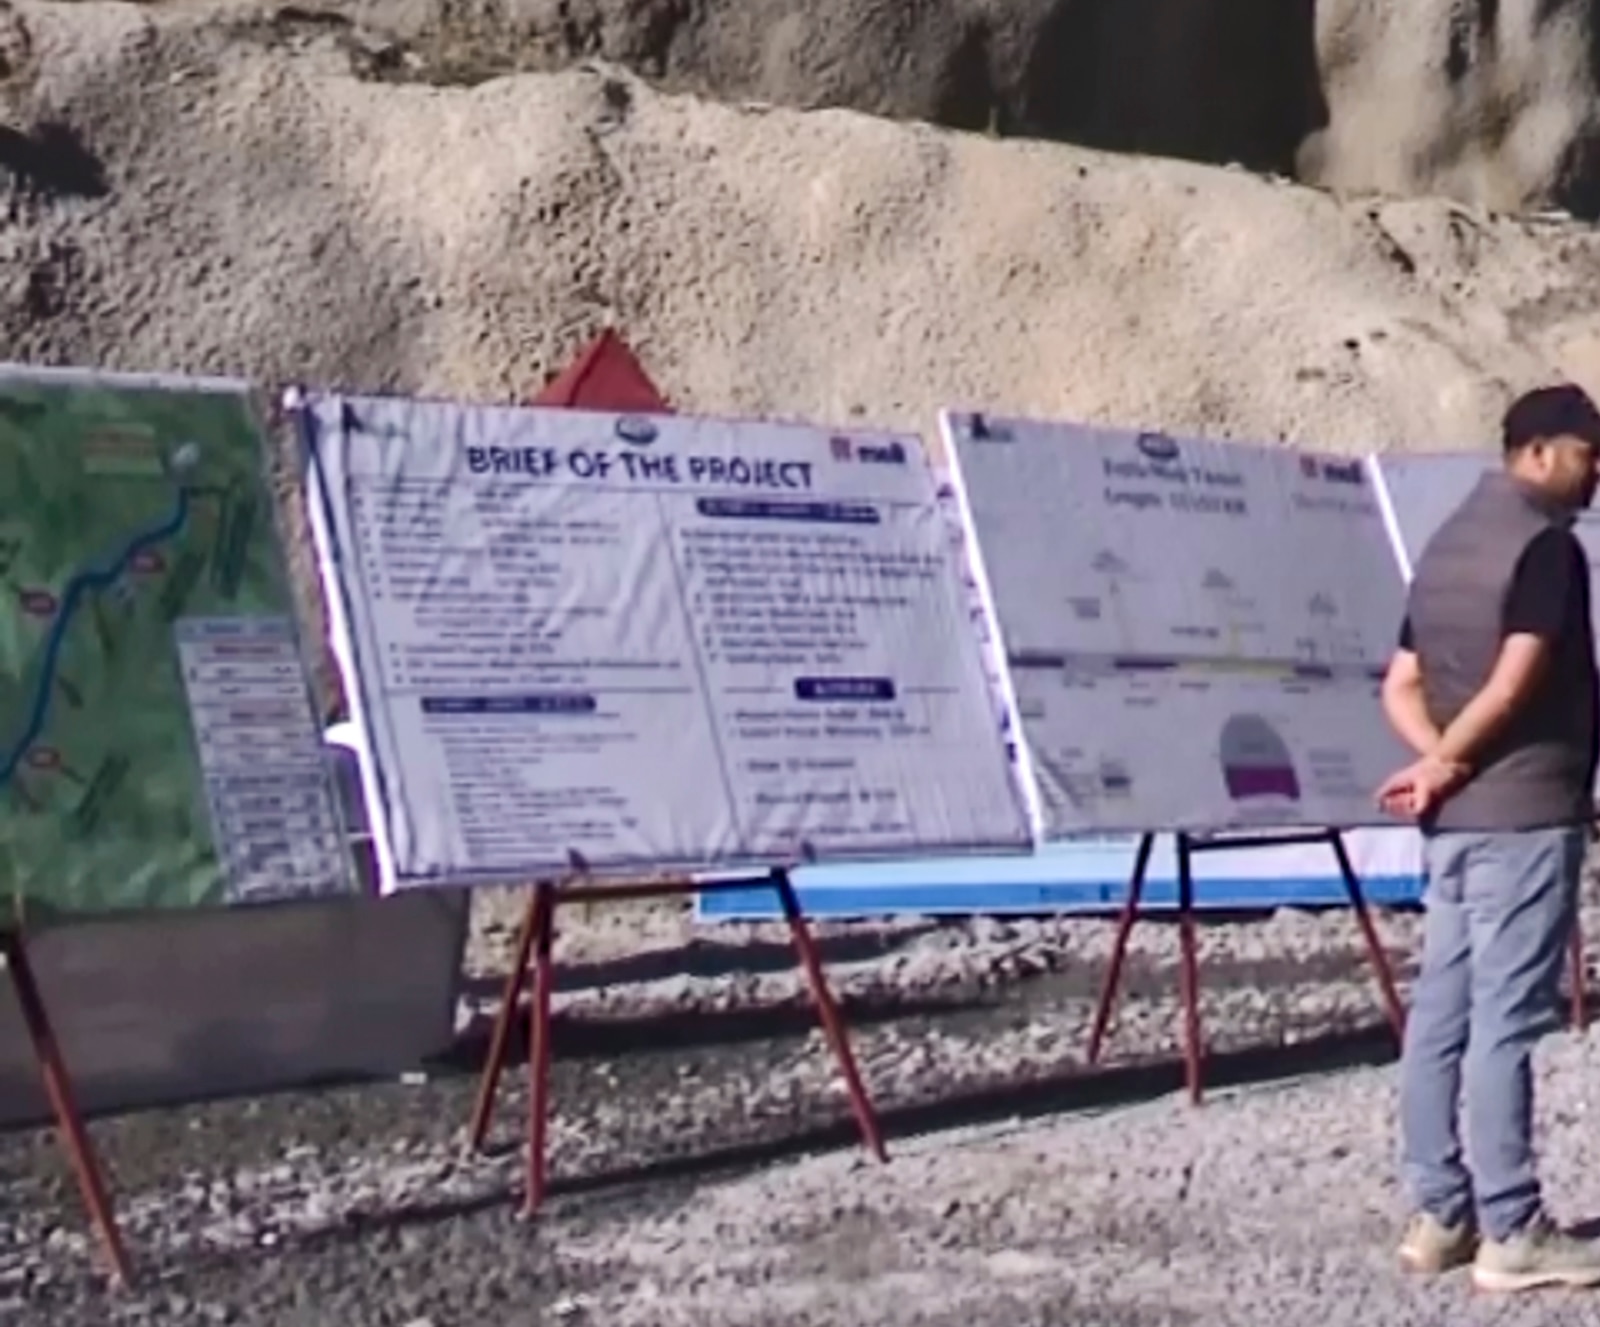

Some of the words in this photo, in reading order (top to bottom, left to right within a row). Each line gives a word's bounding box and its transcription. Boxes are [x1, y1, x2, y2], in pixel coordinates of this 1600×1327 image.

[466, 446, 557, 477] BRIEF
[568, 449, 611, 478] OF
[621, 452, 680, 486] THE
[688, 456, 813, 489] PROJECT
